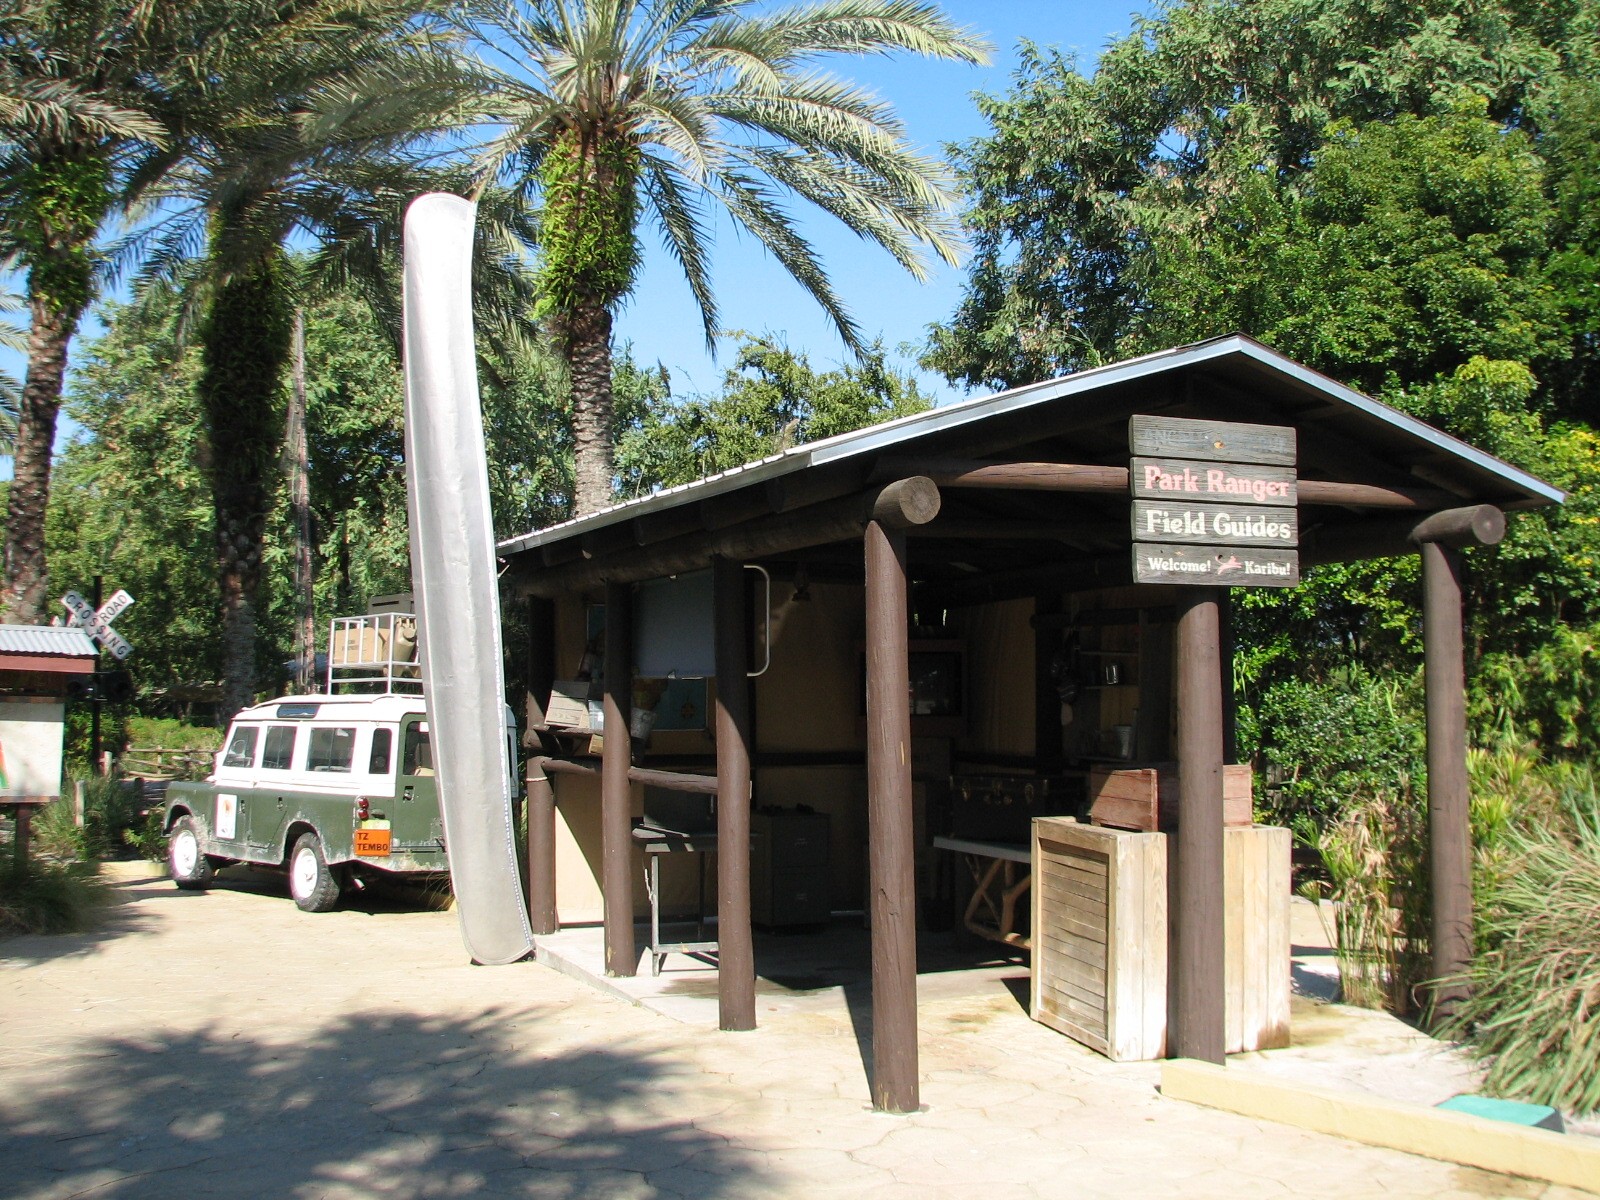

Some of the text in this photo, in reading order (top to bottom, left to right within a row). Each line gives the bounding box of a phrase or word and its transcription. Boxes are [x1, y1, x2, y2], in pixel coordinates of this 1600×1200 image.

[1143, 465, 1290, 502] Park Ranger
[1145, 509, 1292, 539] Field Guides
[1147, 557, 1291, 575] Welcome! Karibu!
[99, 594, 128, 623] ROAD
[66, 594, 127, 655] CROSSING
[357, 832, 369, 841] TZ
[357, 843, 388, 852] TEMBO
